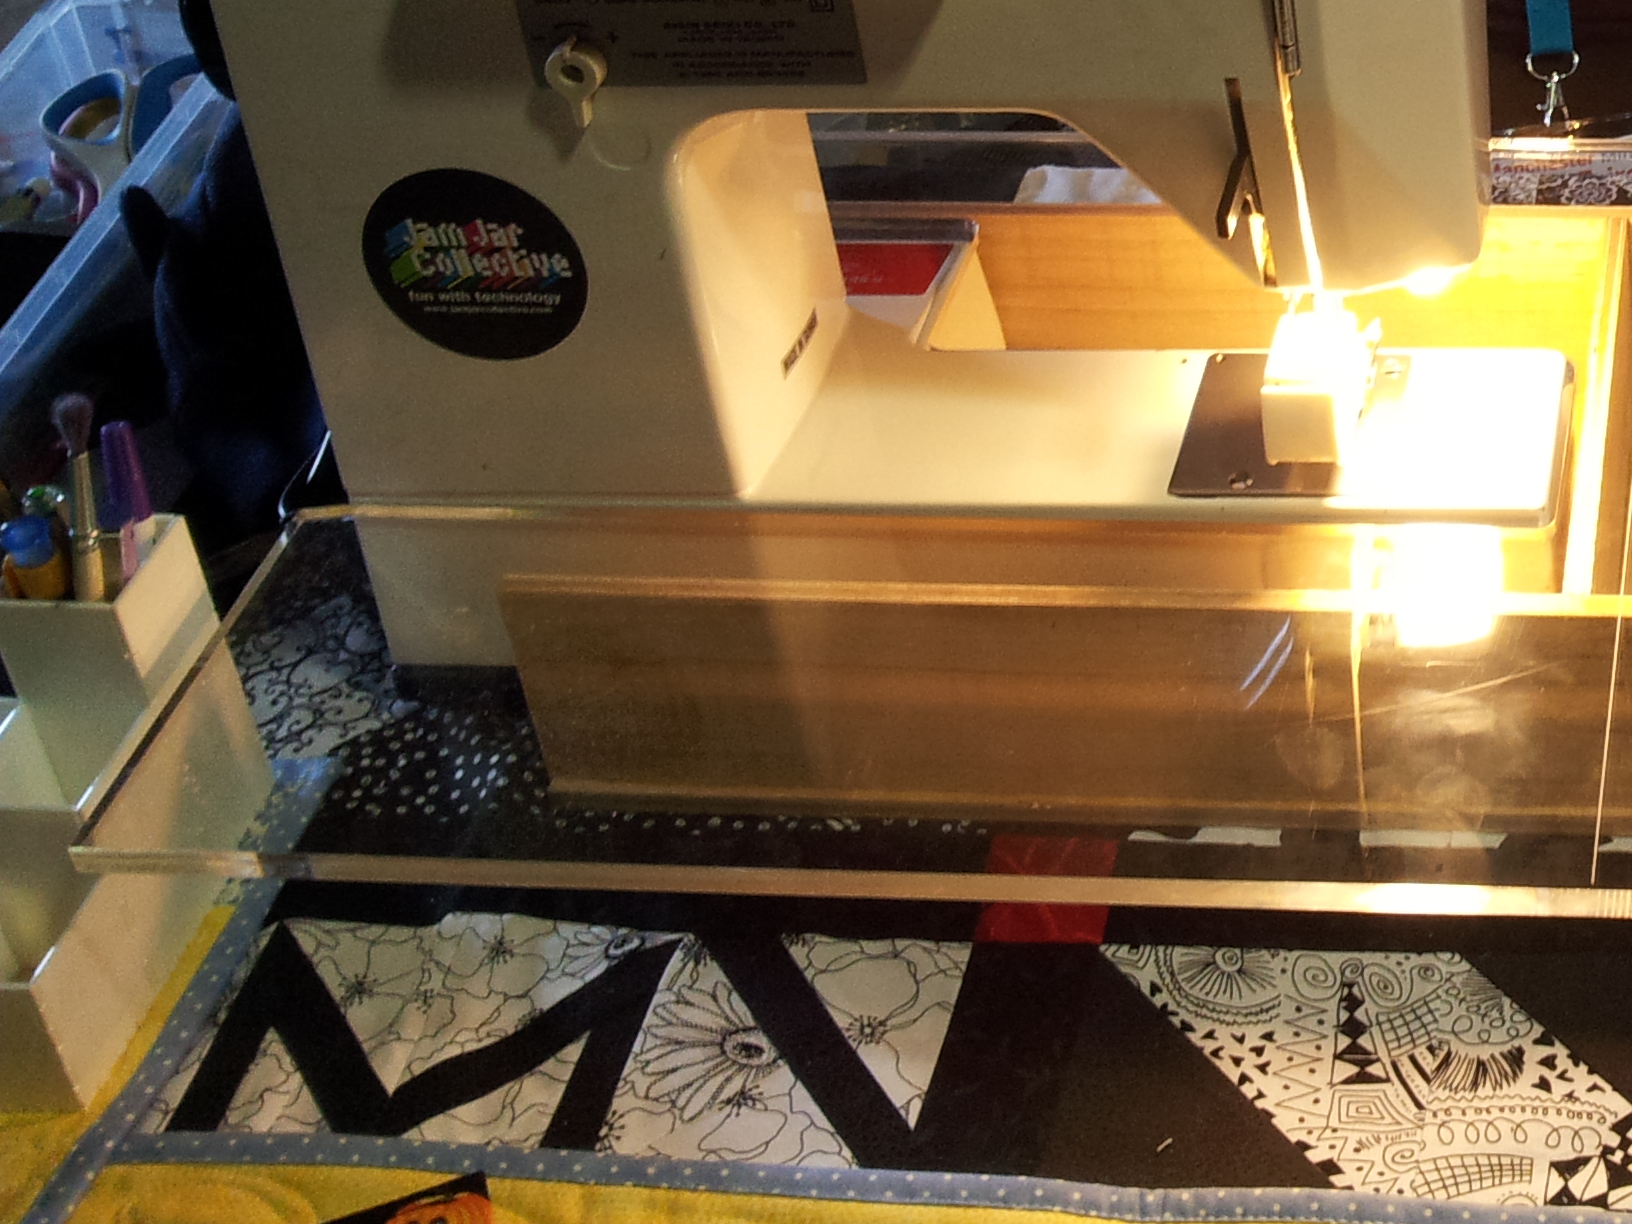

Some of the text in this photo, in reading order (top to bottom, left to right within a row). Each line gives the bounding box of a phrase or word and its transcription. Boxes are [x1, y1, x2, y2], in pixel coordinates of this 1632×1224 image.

[408, 289, 562, 307] fun with technology
